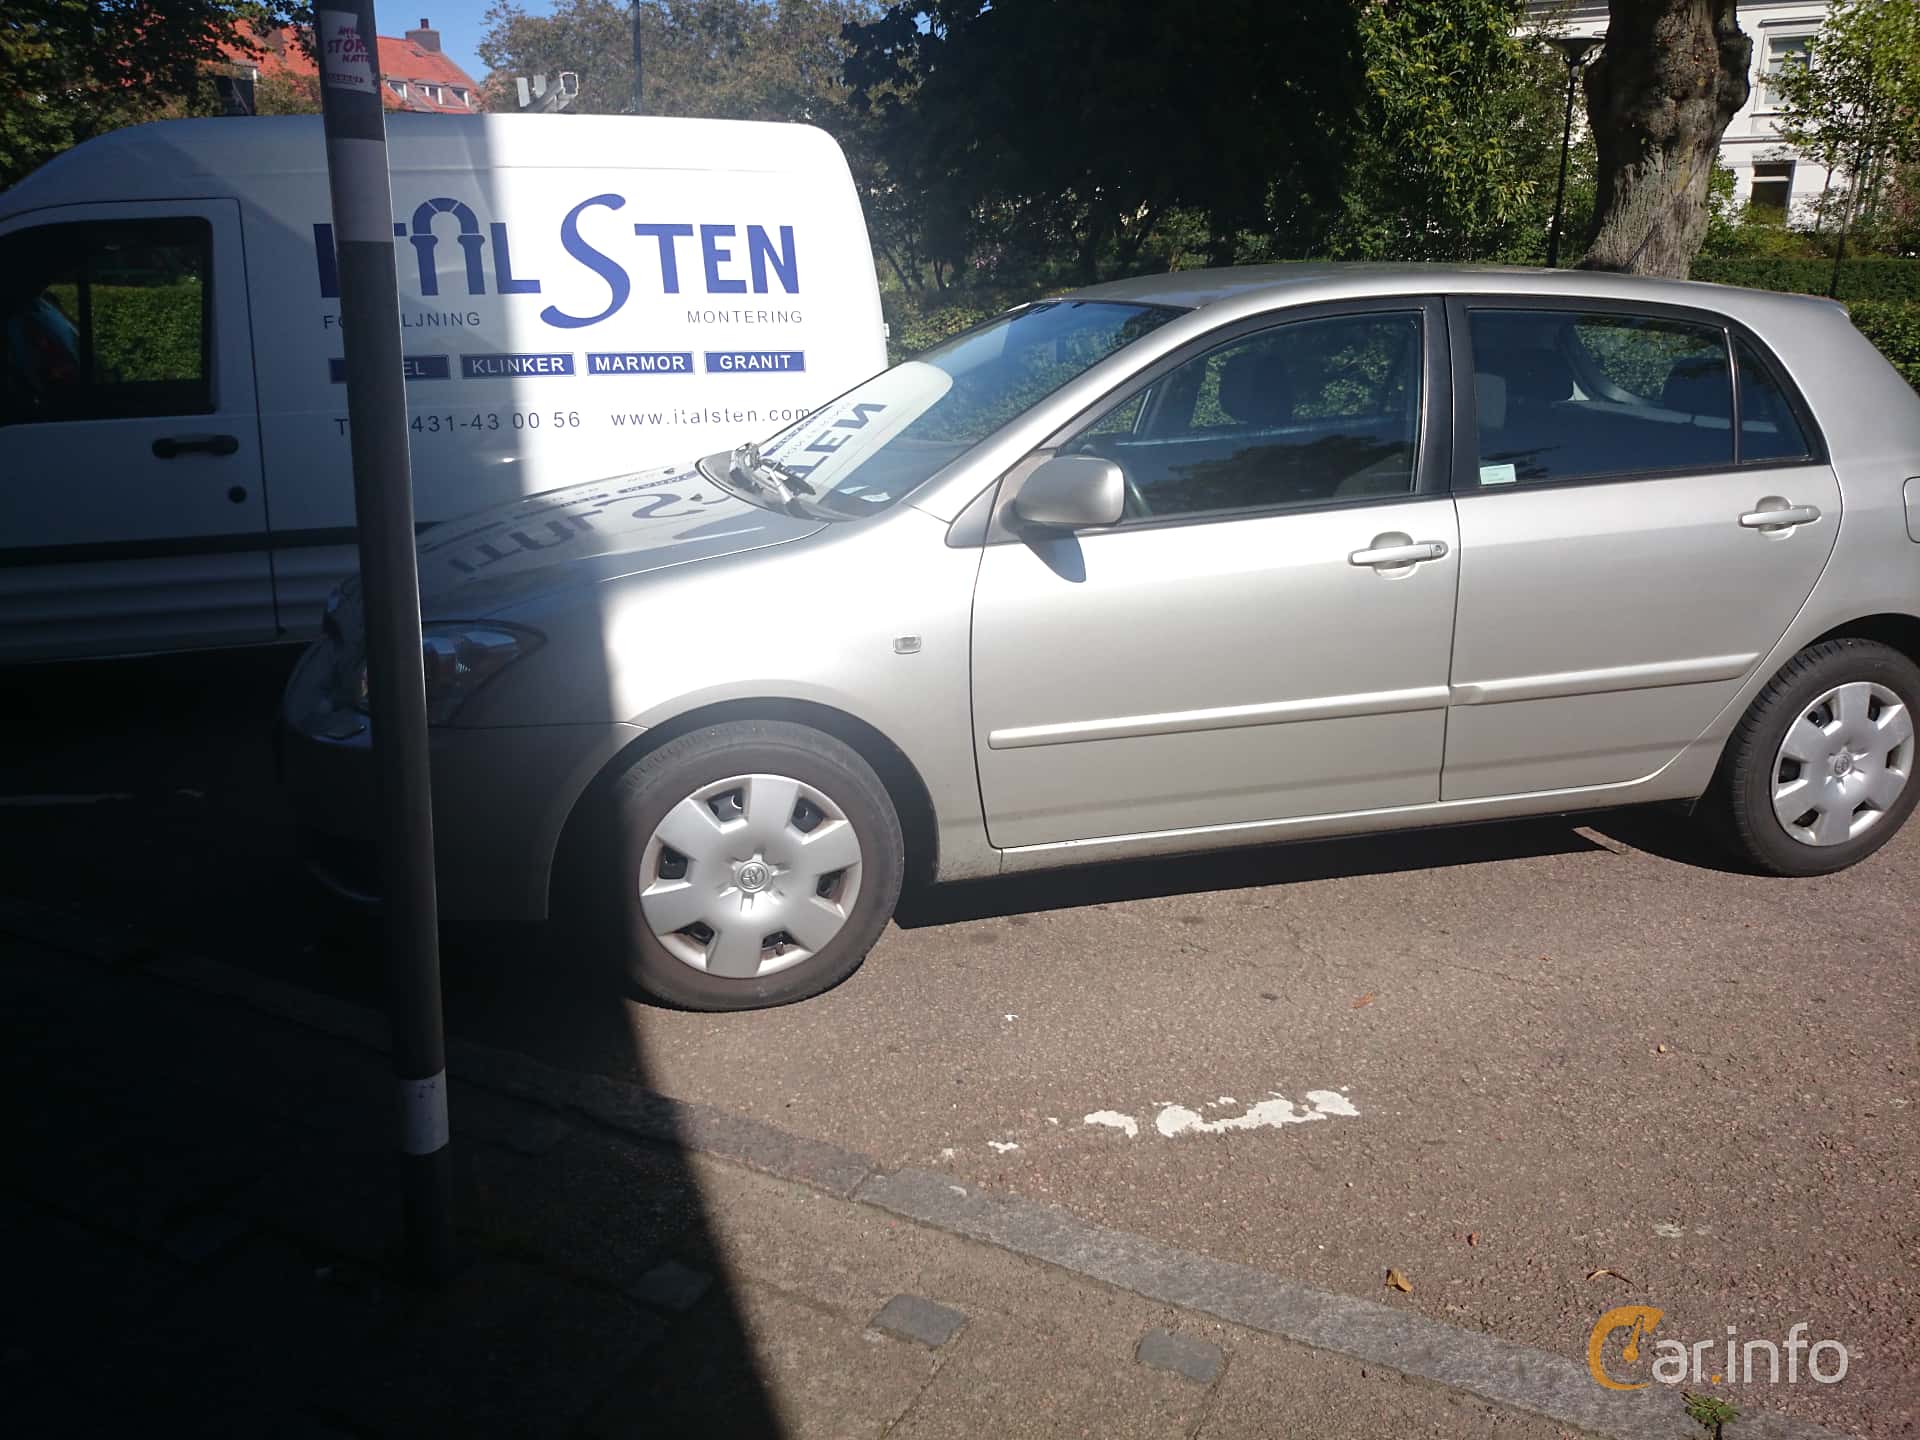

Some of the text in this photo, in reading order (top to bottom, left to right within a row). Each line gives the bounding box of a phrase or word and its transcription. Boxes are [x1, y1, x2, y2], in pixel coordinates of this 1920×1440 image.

[313, 193, 801, 329] IALSTEN
[323, 312, 481, 330] FLJNING
[687, 309, 803, 324] MONTERING
[472, 357, 565, 377] KLINKER
[595, 355, 686, 372] MARMOR
[719, 354, 791, 370] GRANIT
[512, 411, 541, 430] 00
[553, 411, 581, 429] 56
[610, 407, 811, 427] www.italsten.com
